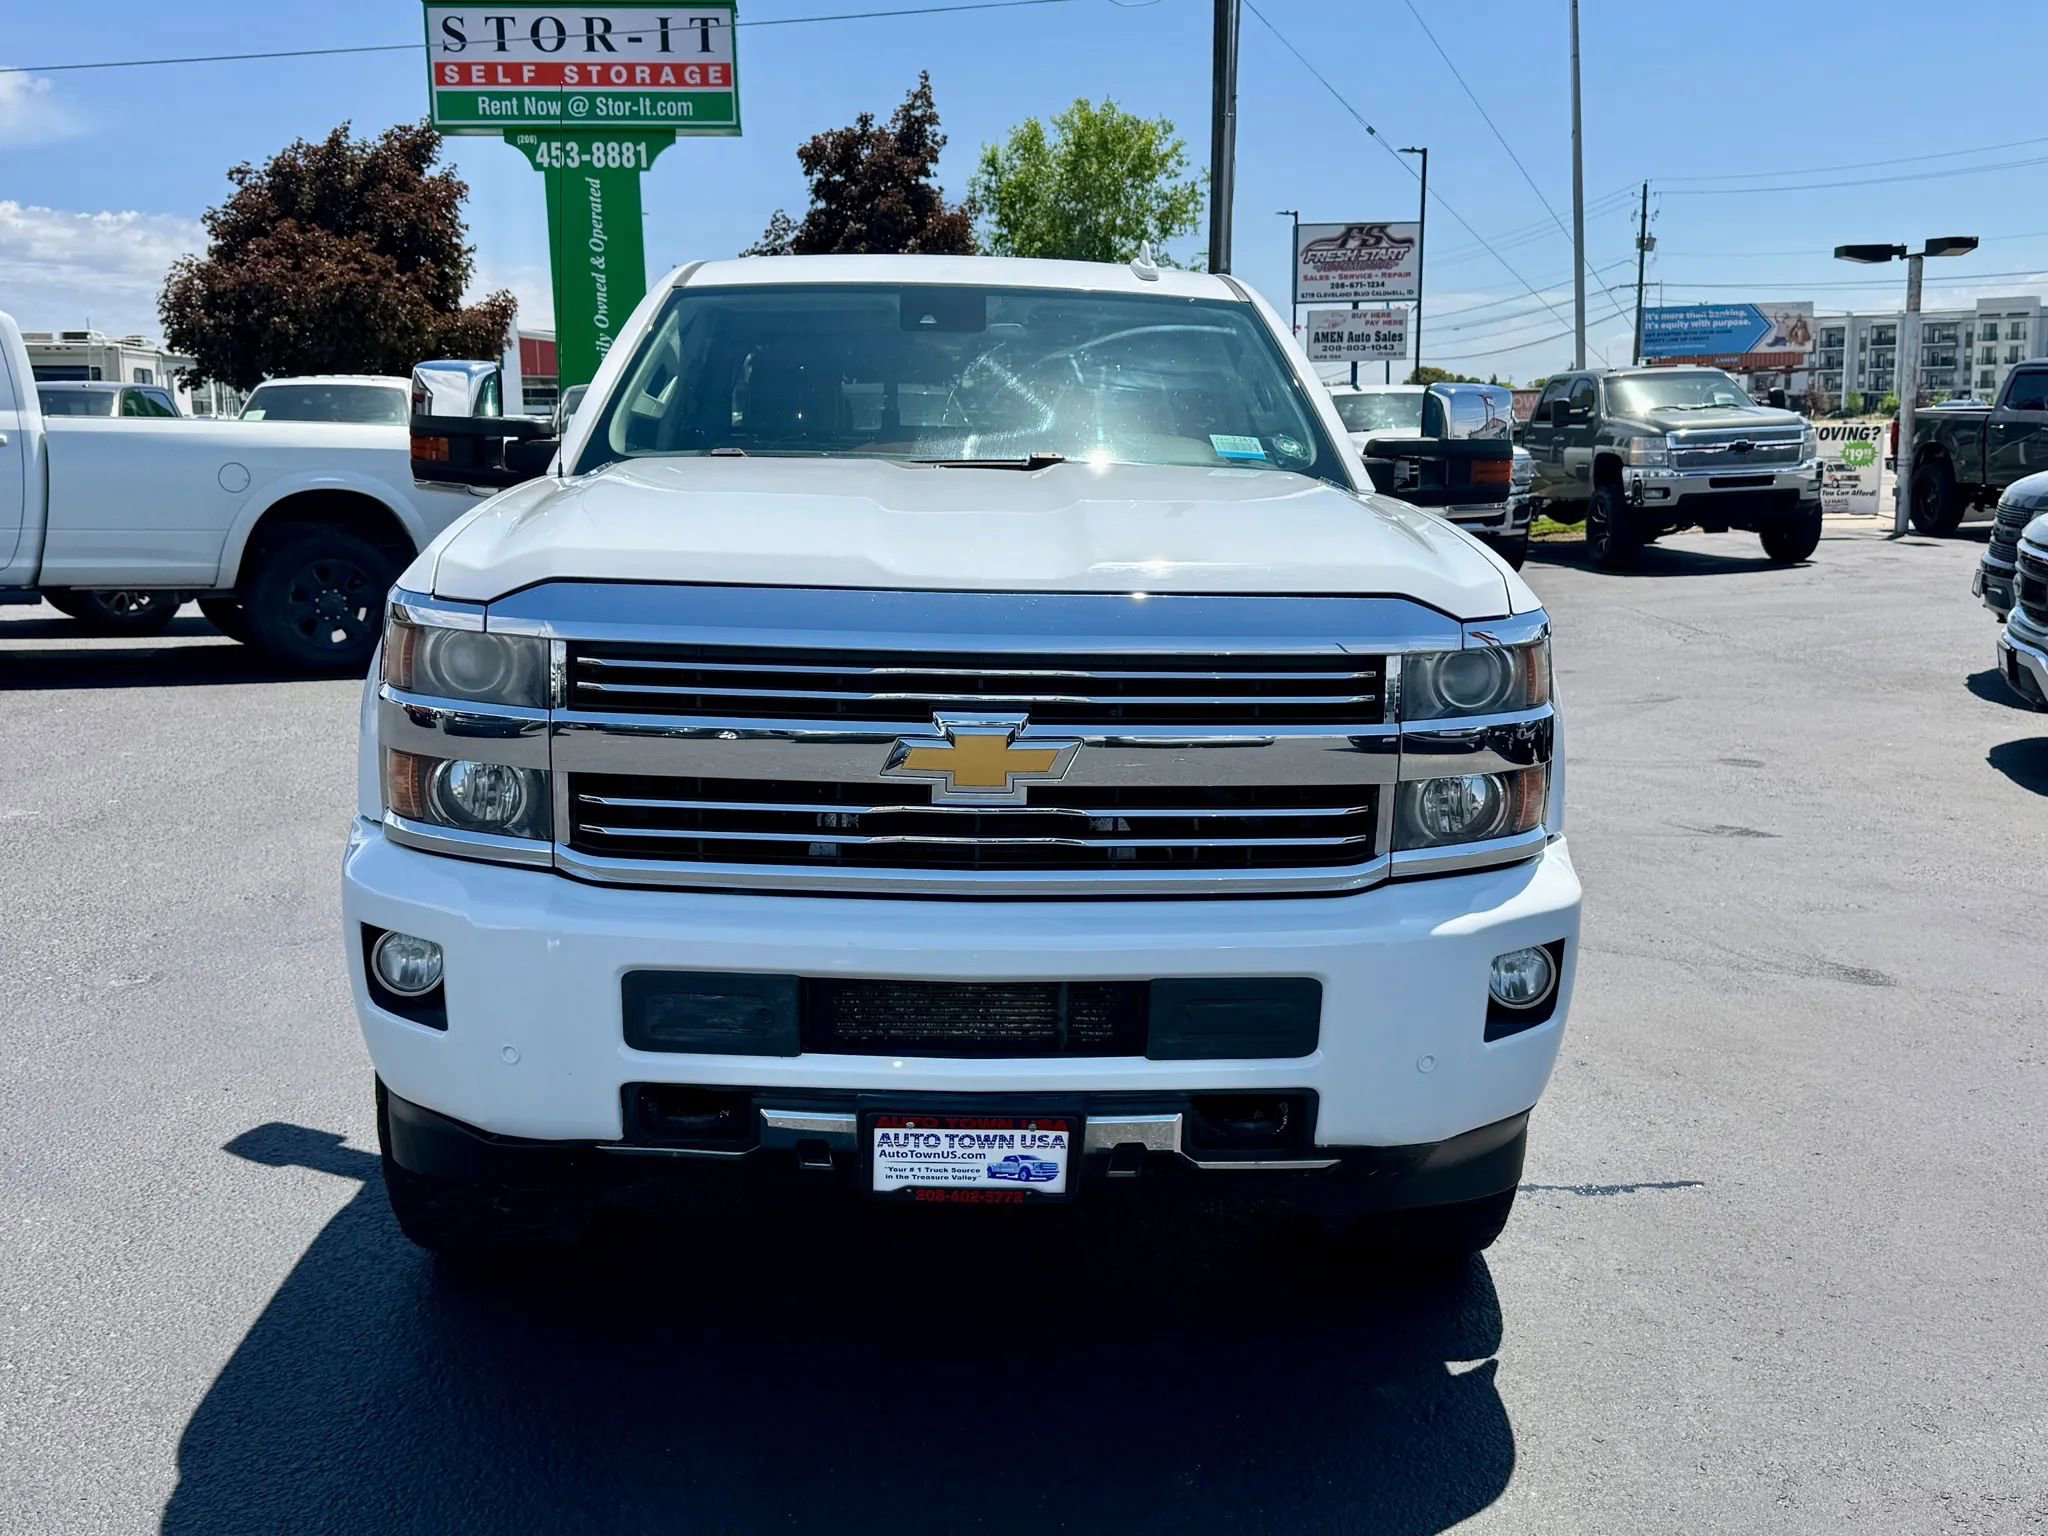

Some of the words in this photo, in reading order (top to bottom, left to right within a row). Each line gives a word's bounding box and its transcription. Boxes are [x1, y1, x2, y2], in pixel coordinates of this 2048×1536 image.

[441, 15, 720, 53] STOR-IT
[444, 65, 535, 84] SELF
[564, 65, 723, 84] STORAGE
[477, 97, 518, 116] Rent
[524, 97, 562, 116] Now
[568, 96, 590, 117] @
[596, 97, 693, 116] Stor-It.com
[517, 134, 538, 145] (208)
[536, 141, 649, 169] 453-8881
[585, 177, 608, 252] Operated
[590, 255, 605, 269] &
[1304, 249, 1358, 263] FRESH
[1358, 248, 1409, 261] START
[591, 273, 610, 329] Owned
[1708, 309, 1747, 318] banking.
[1645, 321, 1658, 329] It's
[1661, 320, 1689, 330] equity
[1691, 319, 1710, 327] with
[1712, 318, 1751, 328] purpose.
[1313, 331, 1344, 343] AMEN
[1347, 331, 1371, 343] Auto
[1374, 330, 1403, 342] Sales
[1321, 344, 1394, 352] 208-803-1043
[1815, 426, 1882, 441] OVING?
[876, 1116, 939, 1129] AUTO
[944, 1118, 1015, 1130] TOWN
[877, 1132, 941, 1148] AUTO
[944, 1133, 1015, 1149] TOWN
[1020, 1134, 1067, 1149] USA
[879, 1149, 986, 1160] AutoTownUS.com
